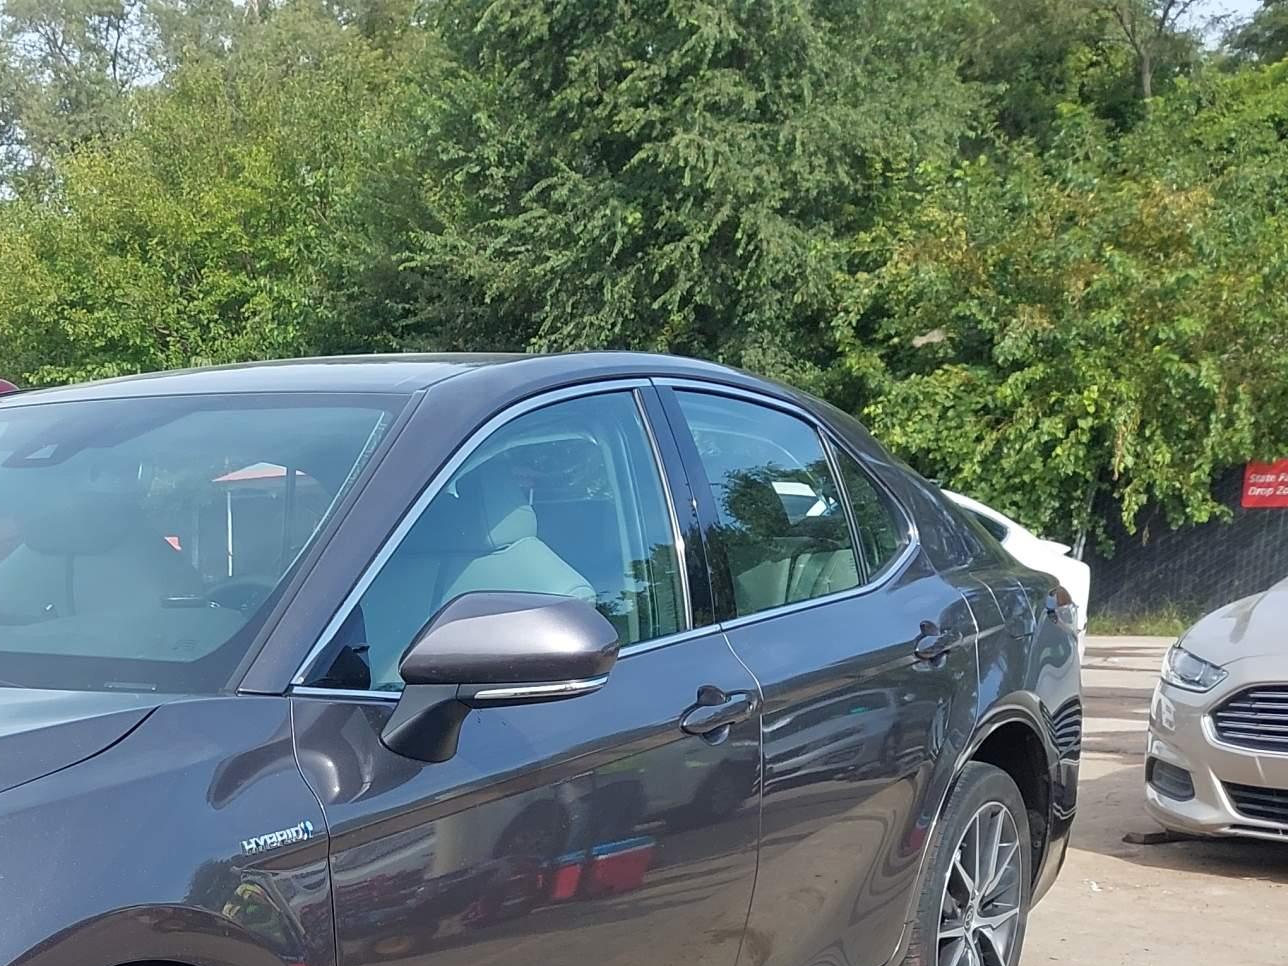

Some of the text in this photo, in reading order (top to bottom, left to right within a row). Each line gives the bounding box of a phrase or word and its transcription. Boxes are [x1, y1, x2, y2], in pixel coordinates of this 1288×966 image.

[1249, 473, 1276, 483] State
[1248, 487, 1274, 496] Drop
[241, 826, 302, 853] HYBRID
